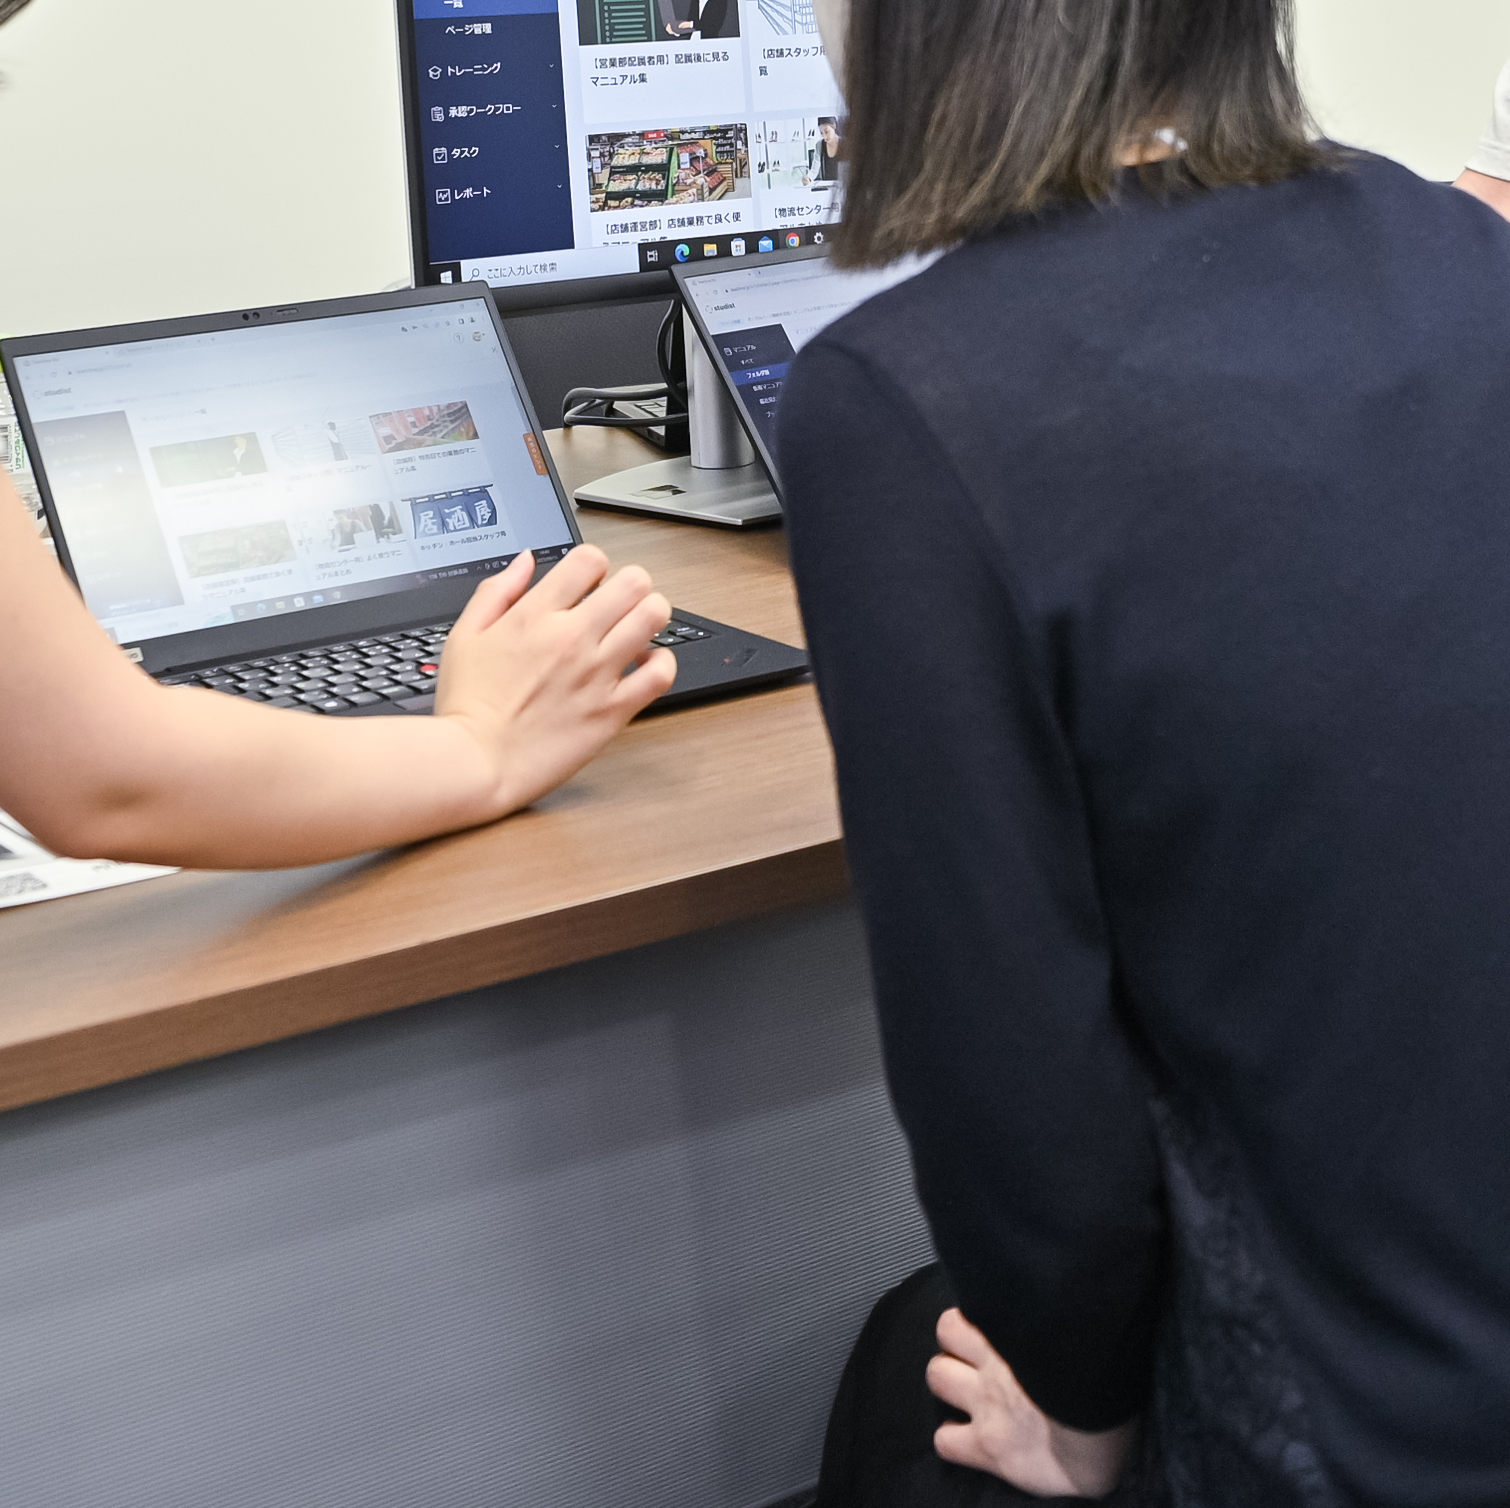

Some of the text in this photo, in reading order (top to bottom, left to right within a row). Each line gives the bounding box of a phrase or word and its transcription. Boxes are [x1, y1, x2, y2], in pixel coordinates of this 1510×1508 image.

[445, 23, 492, 35] ページ管理
[447, 61, 501, 76] トレーニング
[590, 72, 648, 87] マニュアル集
[448, 104, 522, 118] 承認ワークフロー
[451, 147, 479, 159] タスク
[454, 186, 492, 200] レポート
[486, 262, 558, 280] ここに入力して検索
[418, 499, 492, 534] 居酒屋
